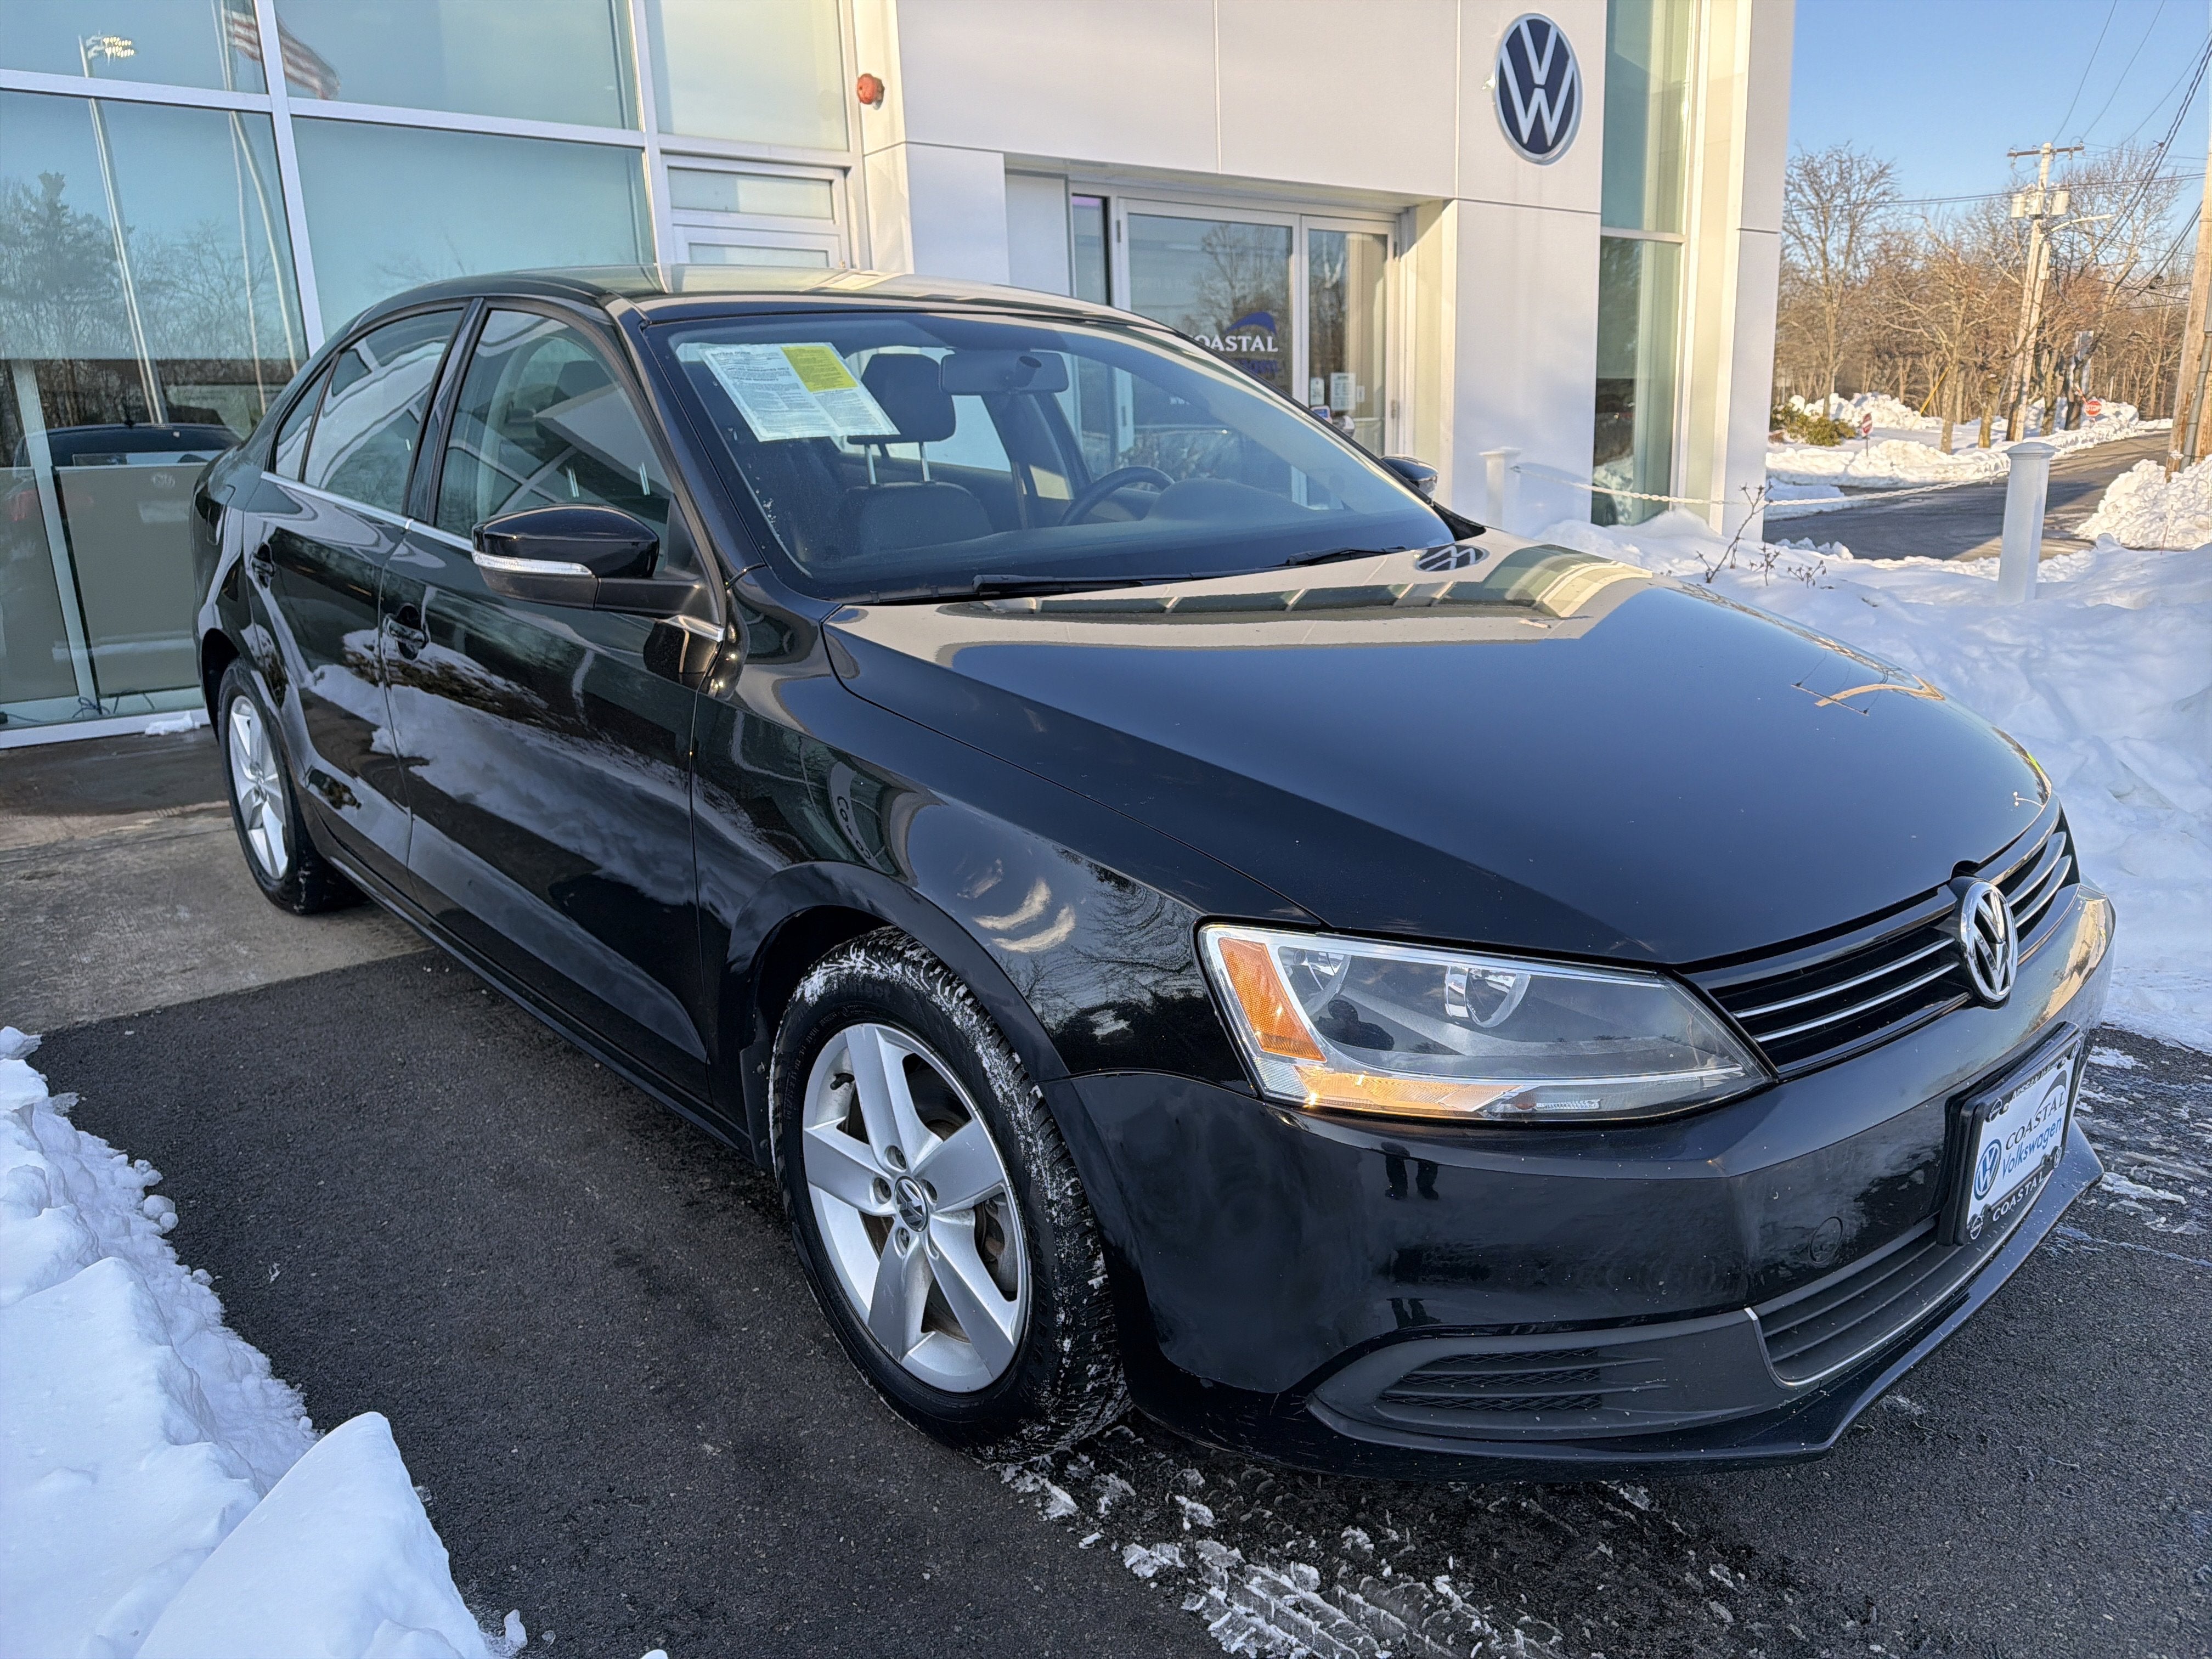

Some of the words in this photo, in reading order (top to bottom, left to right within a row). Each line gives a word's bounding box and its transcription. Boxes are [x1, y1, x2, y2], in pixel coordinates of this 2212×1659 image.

[1189, 334, 1279, 352] OASTAL
[2006, 1091, 2065, 1150] COASTAL
[2003, 1118, 2062, 1179] Volkswagen
[1993, 1171, 2044, 1222] COASTAL
